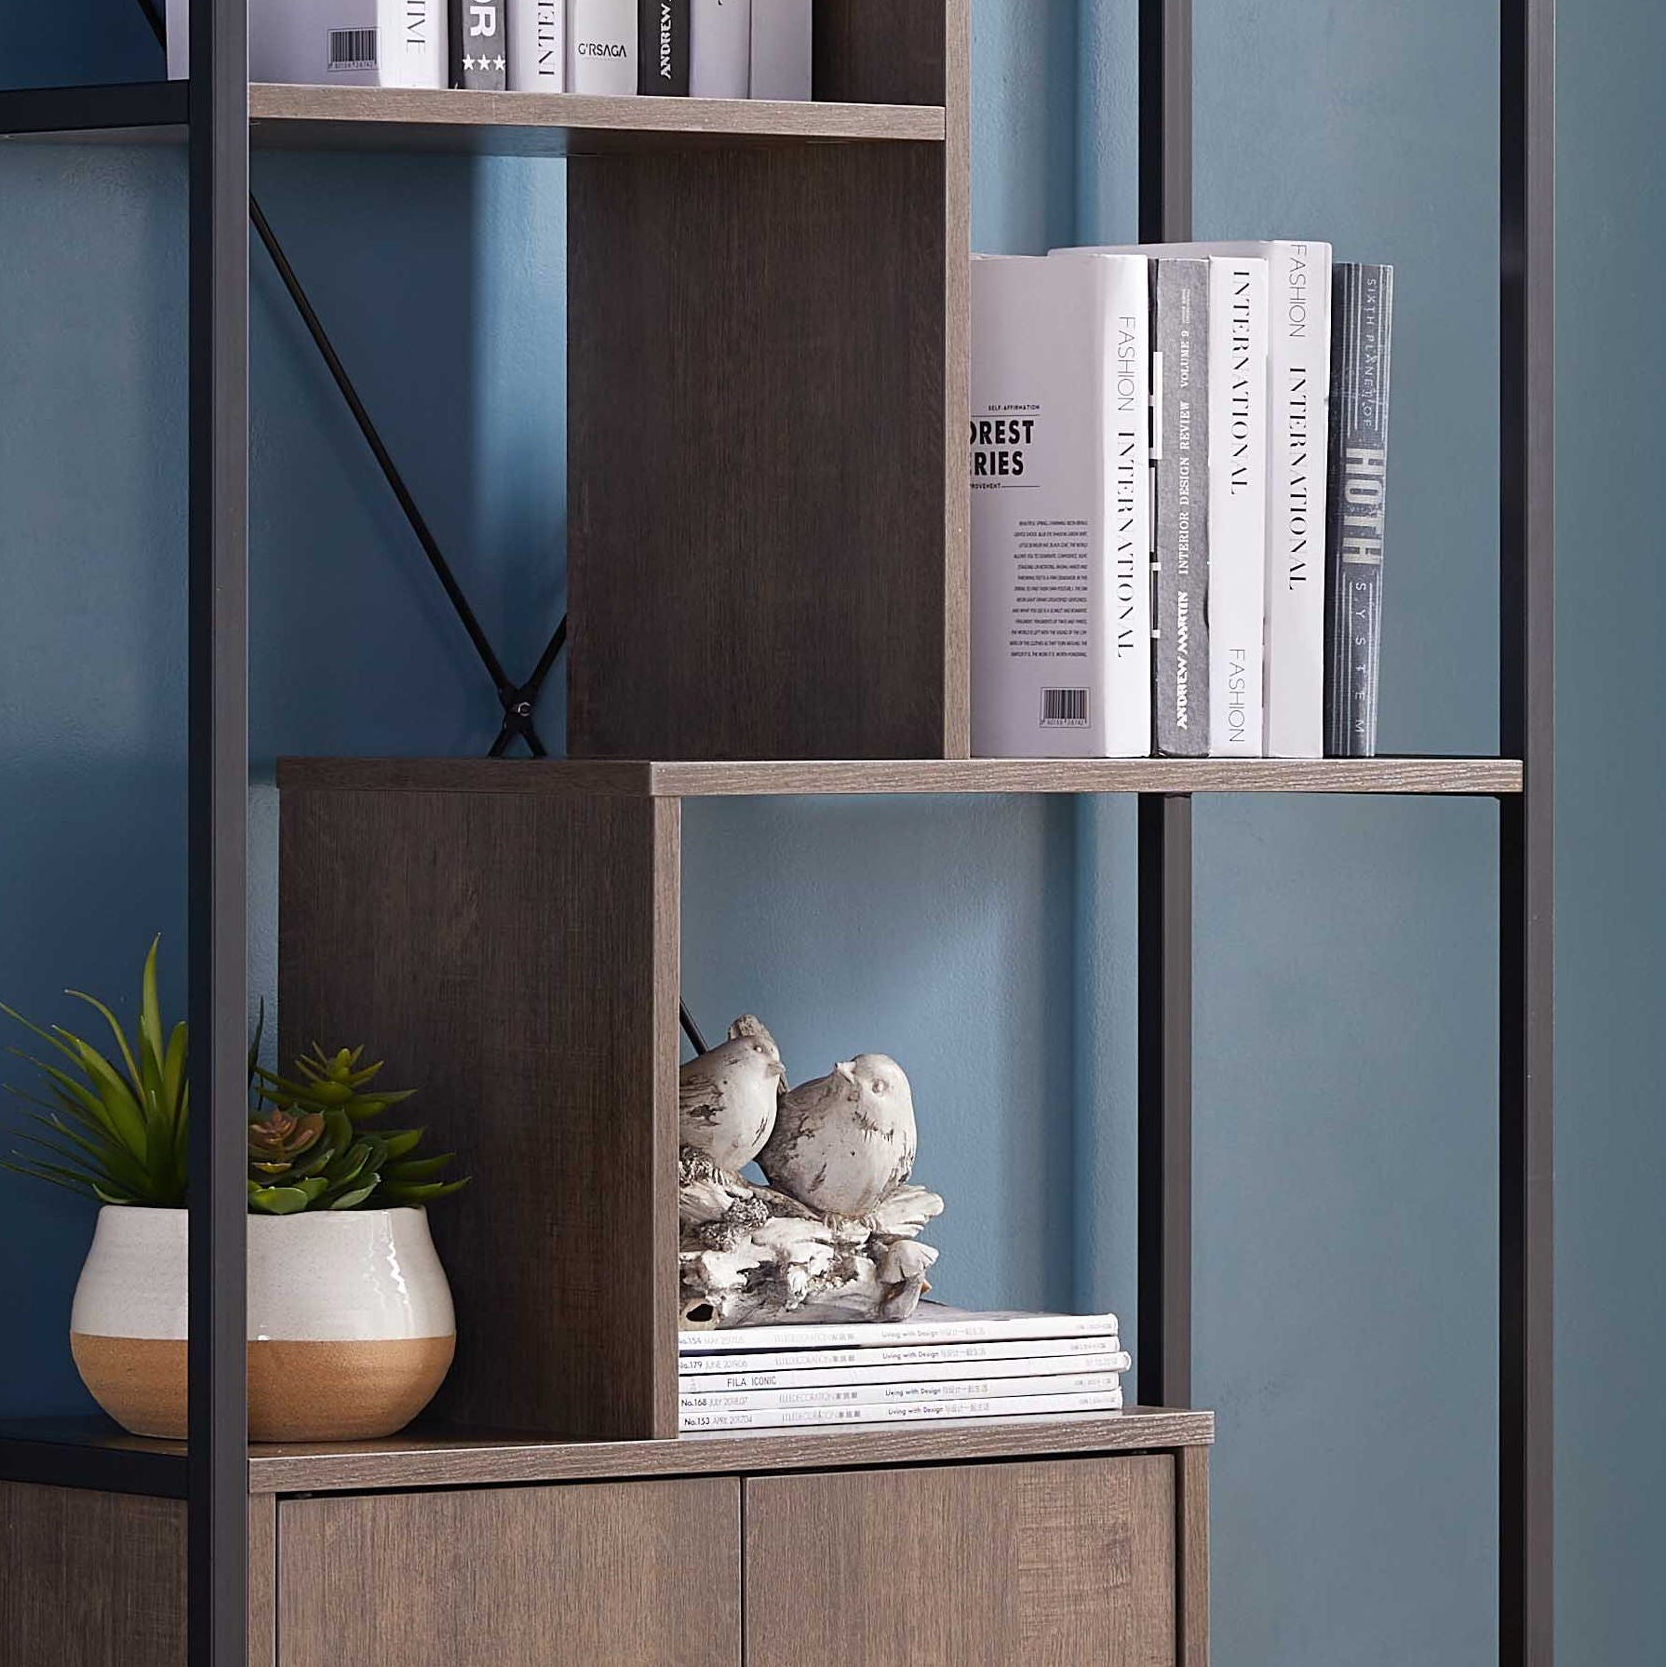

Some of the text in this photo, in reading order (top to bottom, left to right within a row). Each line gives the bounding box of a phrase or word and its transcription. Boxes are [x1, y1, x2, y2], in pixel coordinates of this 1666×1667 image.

[660, 3, 672, 79] ANDREW
[1365, 279, 1376, 325] SIXTH
[1180, 341, 1190, 388] VOLUME
[970, 420, 1034, 445] OREST
[1179, 401, 1190, 450] REVIEW
[1288, 244, 1308, 590] FASHION INTERNATIONAL
[974, 451, 1024, 476] RIES
[1116, 317, 1135, 657] FASHION INTERNATIONAL
[1179, 457, 1190, 506] DESIGN
[1228, 271, 1250, 742] INTERNATIONAL FASHION
[1341, 448, 1384, 565] HOTH
[1178, 512, 1189, 575] INTERIOR
[1177, 591, 1189, 655] MARTIN
[1176, 656, 1188, 730] ANDREW
[882, 1351, 901, 1360] Living
[918, 1350, 939, 1359] Design
[727, 1375, 777, 1388] FILA ICONIC
[920, 1387, 941, 1396] Design
[888, 1407, 906, 1416] Living
[923, 1405, 943, 1414] Design
